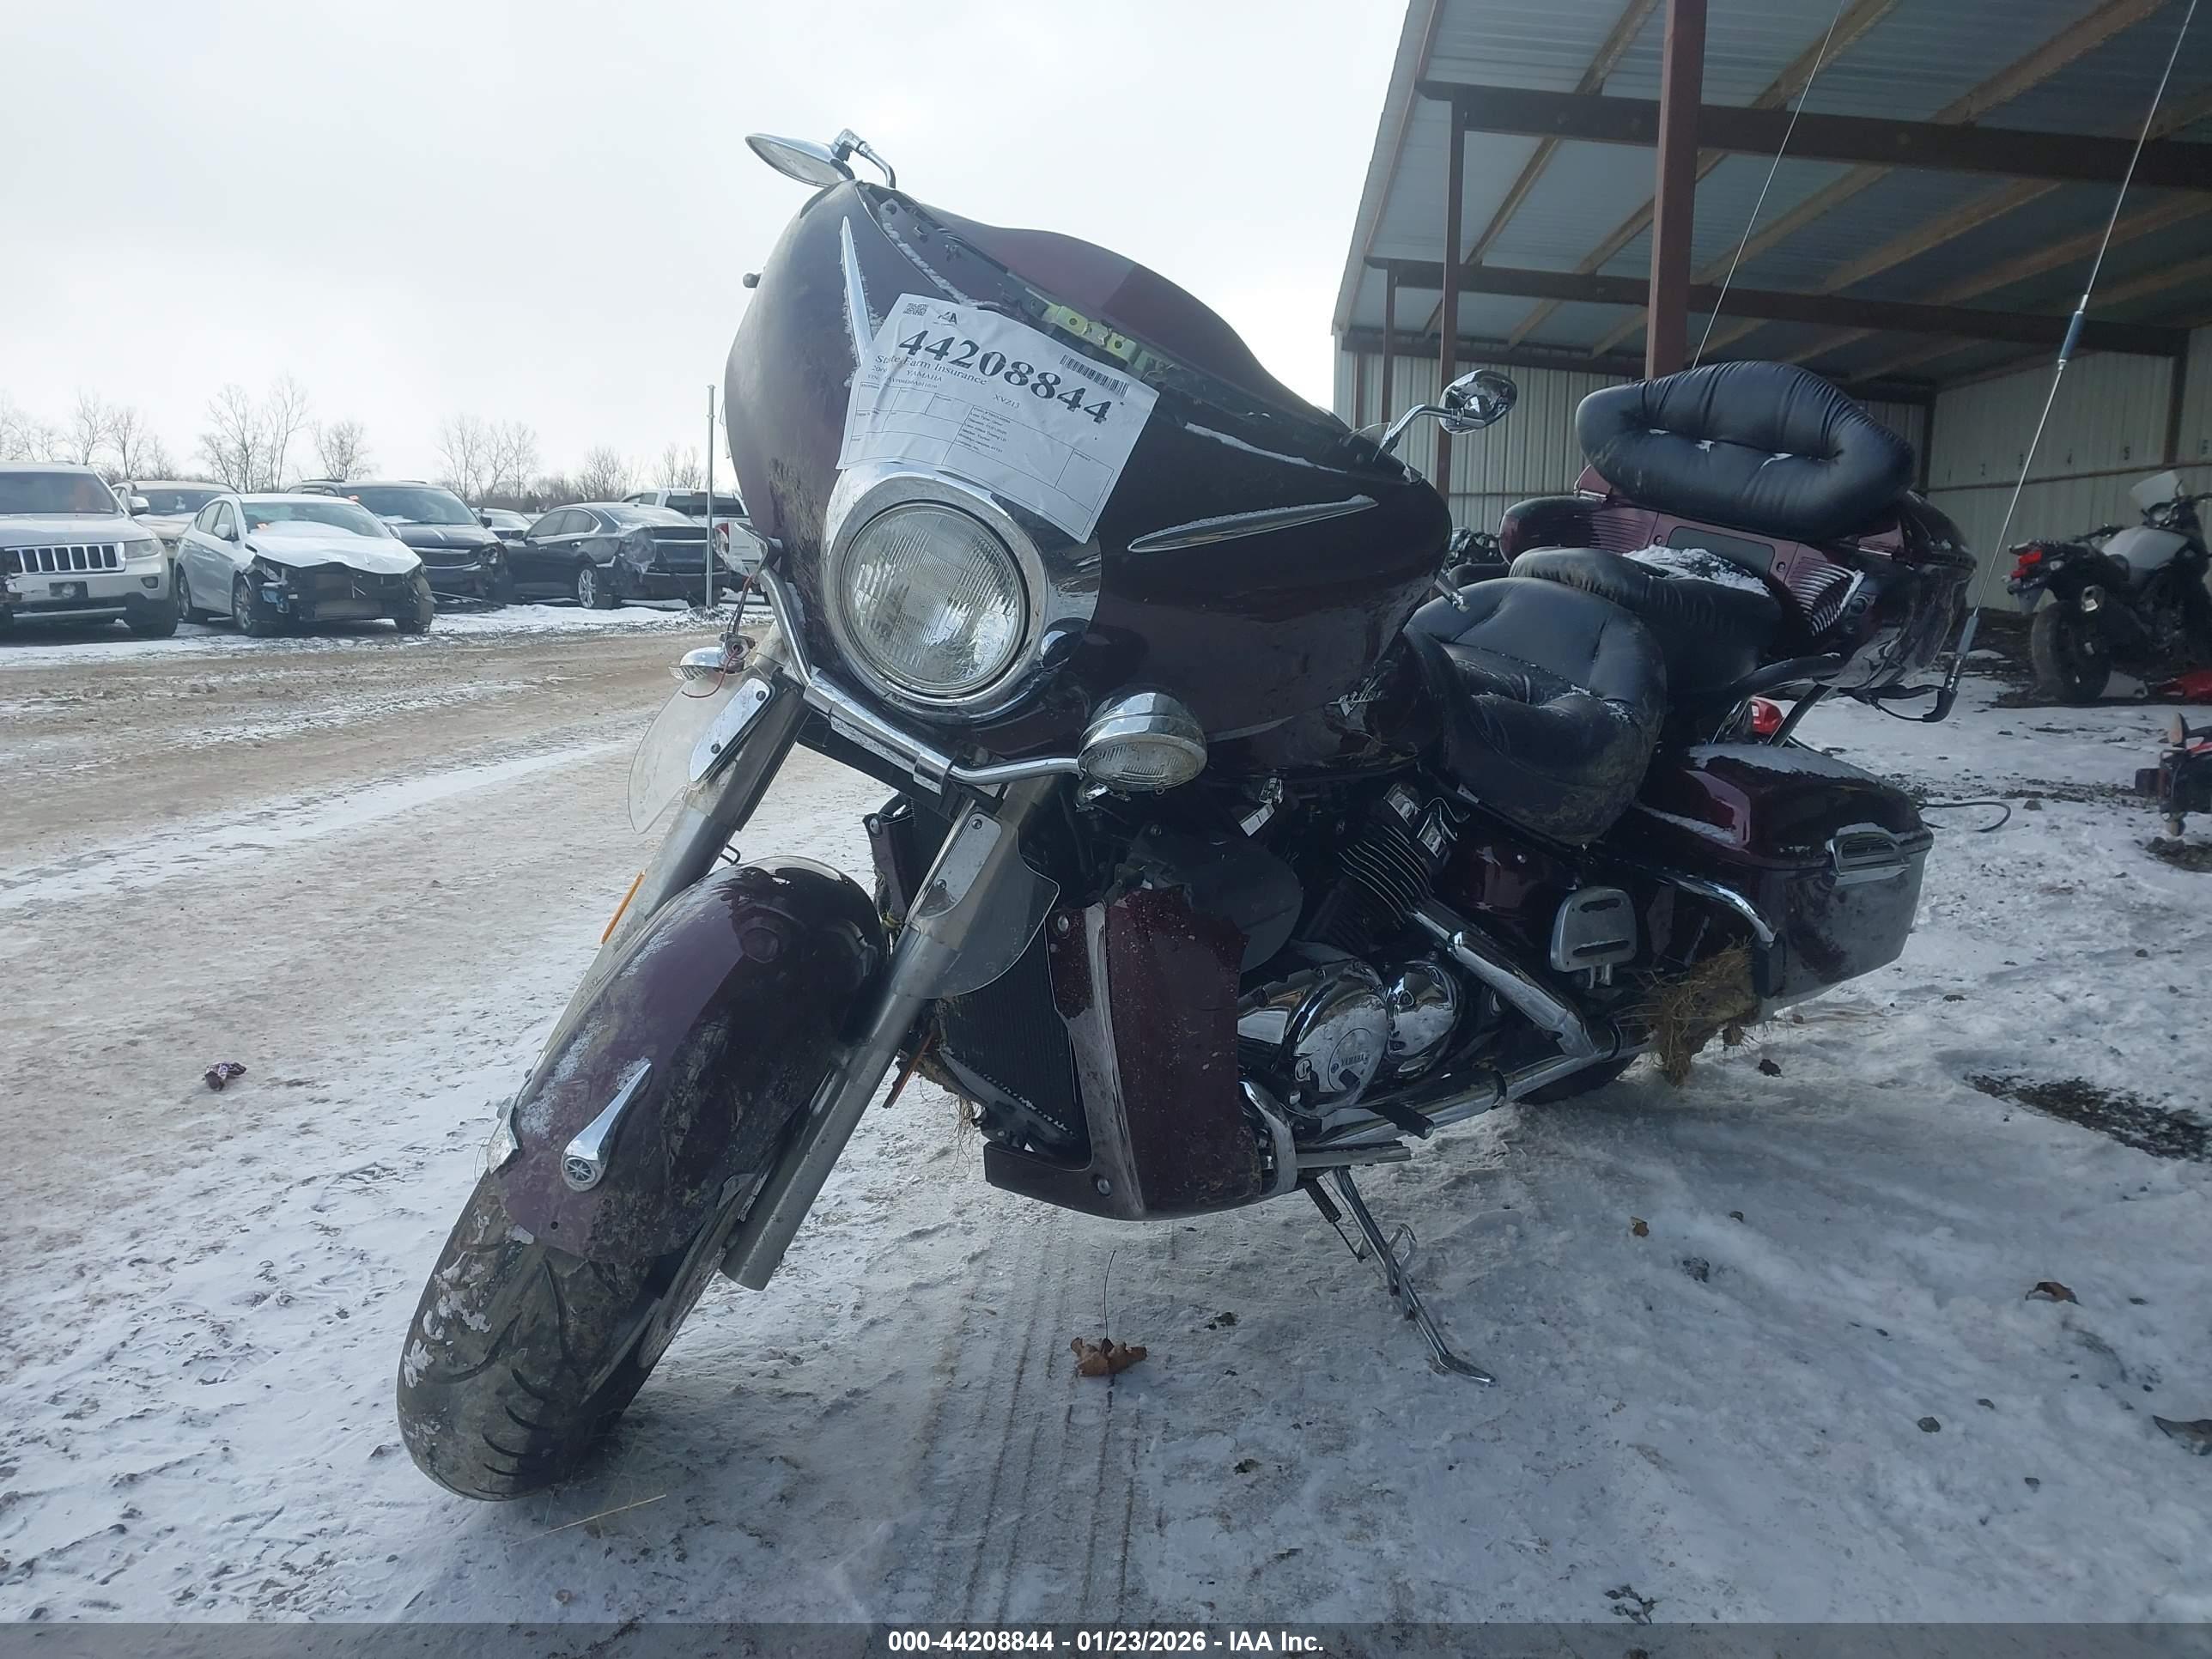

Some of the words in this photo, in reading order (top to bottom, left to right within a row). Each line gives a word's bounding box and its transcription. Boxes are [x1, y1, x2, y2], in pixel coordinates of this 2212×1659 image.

[874, 355, 901, 365] State
[903, 356, 932, 369] Farm
[934, 361, 988, 386] Insurance
[898, 330, 1113, 425] 44208844
[993, 392, 1021, 410] XVZ13
[1340, 1054, 1365, 1066] YAMAHA
